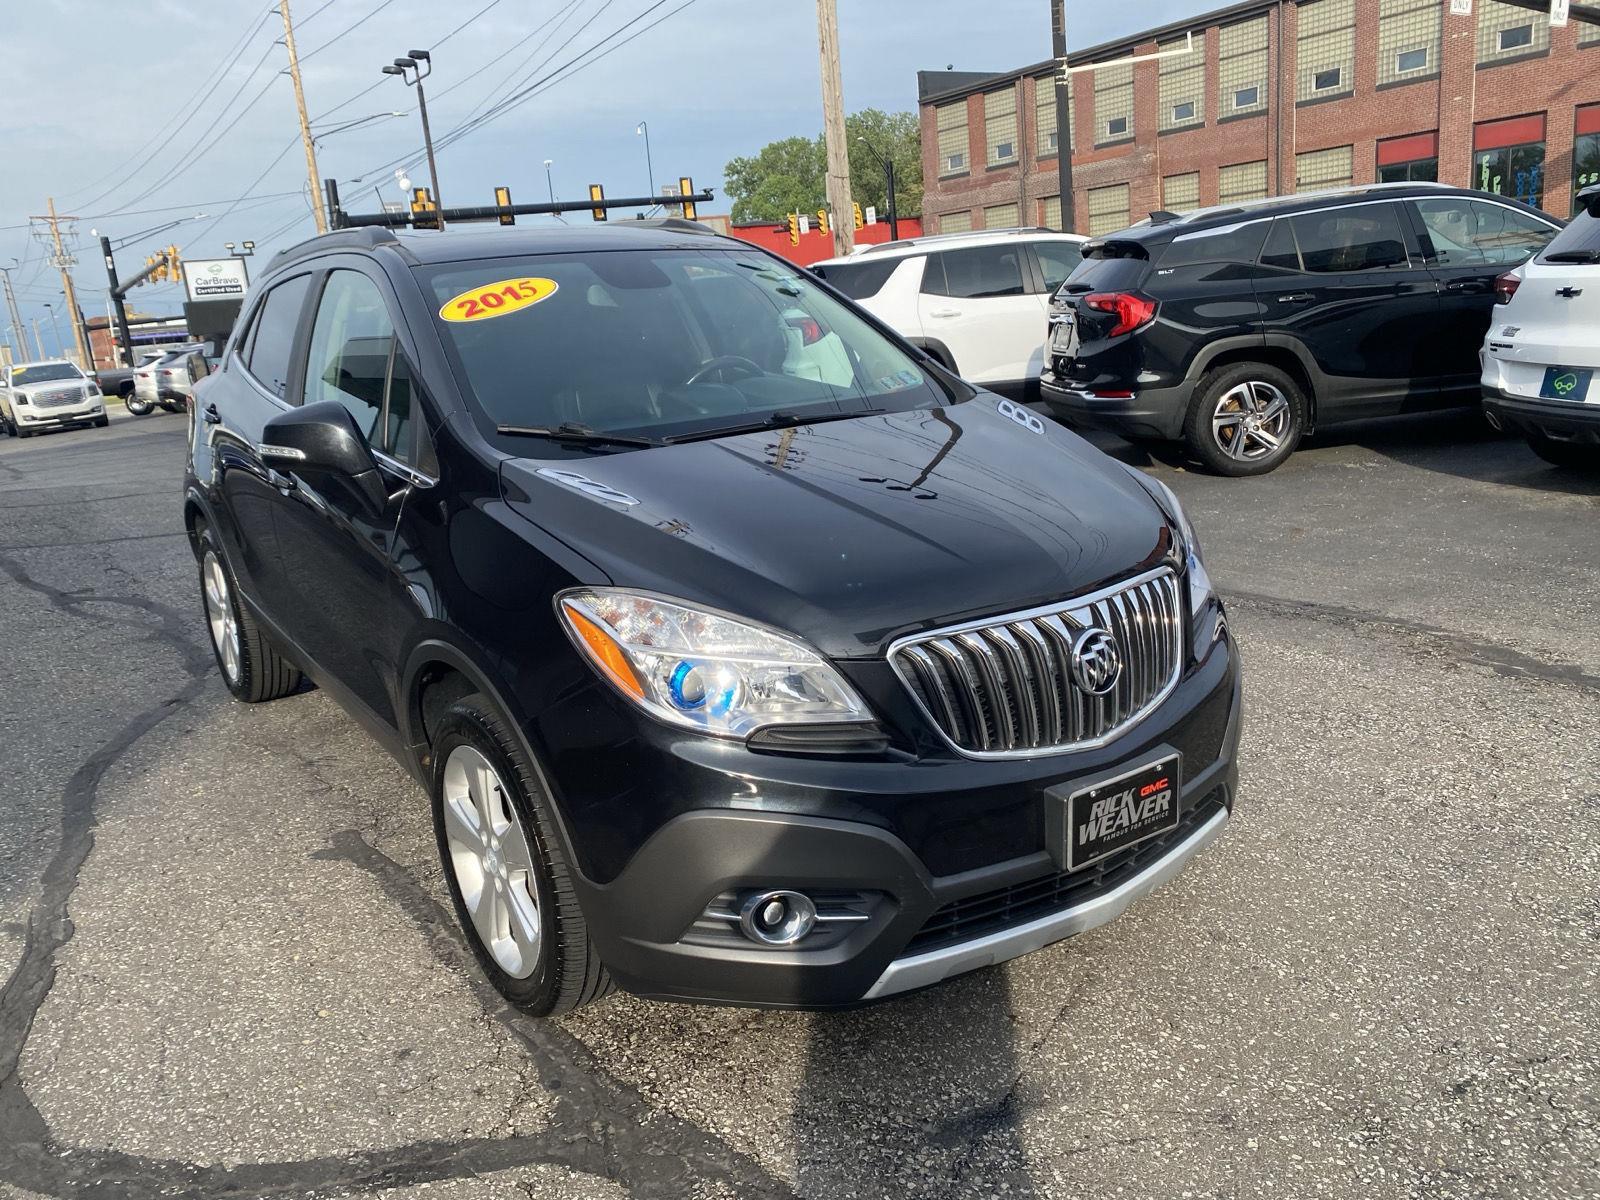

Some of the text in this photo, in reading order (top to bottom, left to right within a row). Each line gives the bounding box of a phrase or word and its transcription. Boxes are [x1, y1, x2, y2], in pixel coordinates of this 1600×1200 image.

[1453, 0, 1470, 10] ONLY
[195, 276, 239, 286] CarBravo
[196, 287, 226, 295] Certified
[457, 280, 538, 319] 2015
[1140, 778, 1169, 797] GMC
[1089, 787, 1137, 822] RICK
[1079, 789, 1172, 846] WEAVER
[1102, 811, 1169, 843] FAMOUS FOR SERVICE
